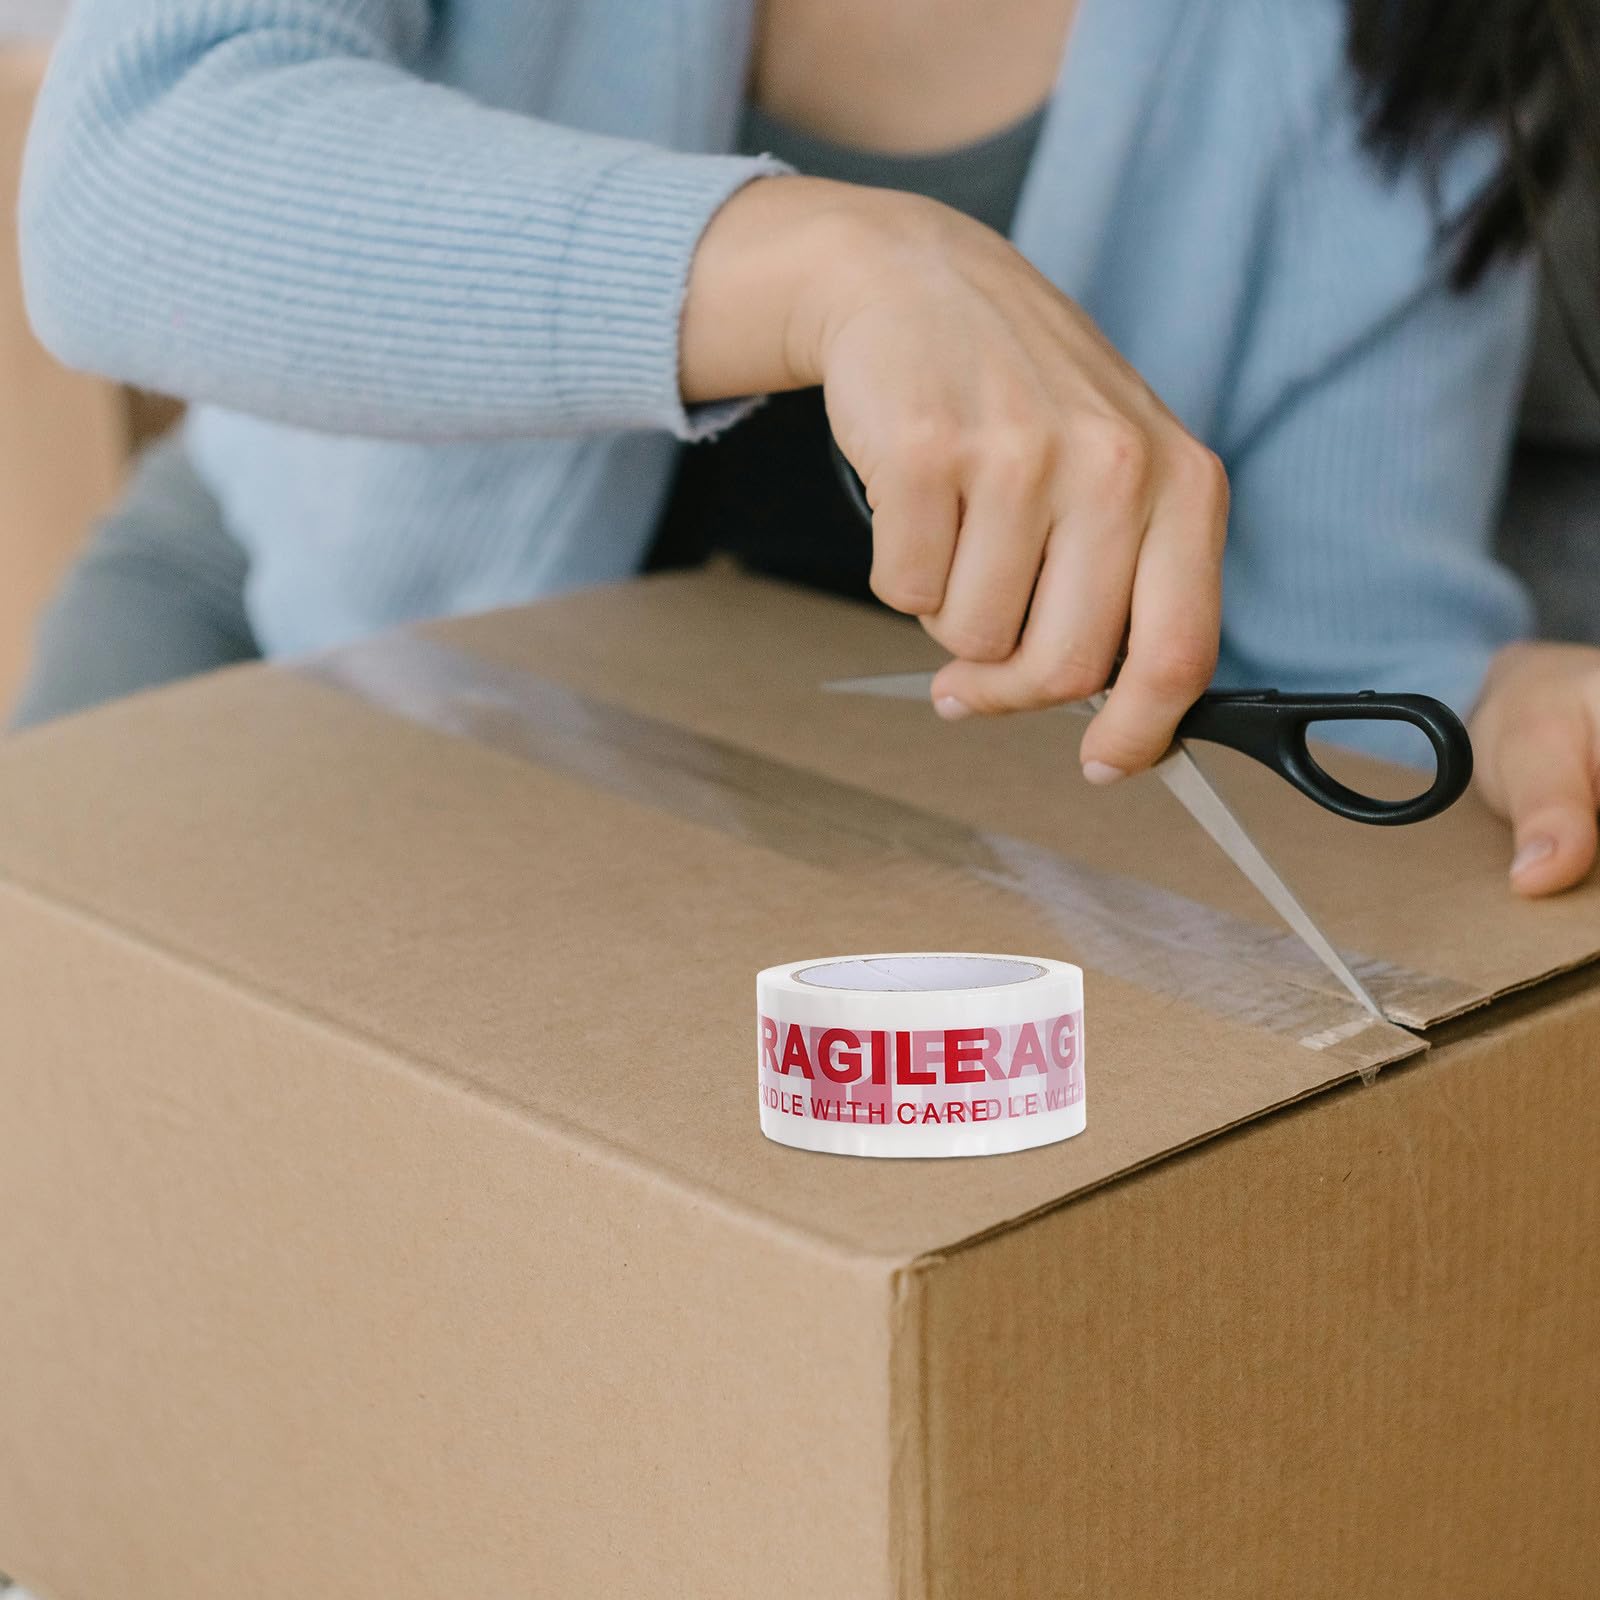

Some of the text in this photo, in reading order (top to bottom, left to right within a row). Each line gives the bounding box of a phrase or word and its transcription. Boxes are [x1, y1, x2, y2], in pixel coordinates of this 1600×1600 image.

[912, 1014, 1083, 1080] FRAG
[761, 1084, 987, 1125] NDLE WITH CARE
